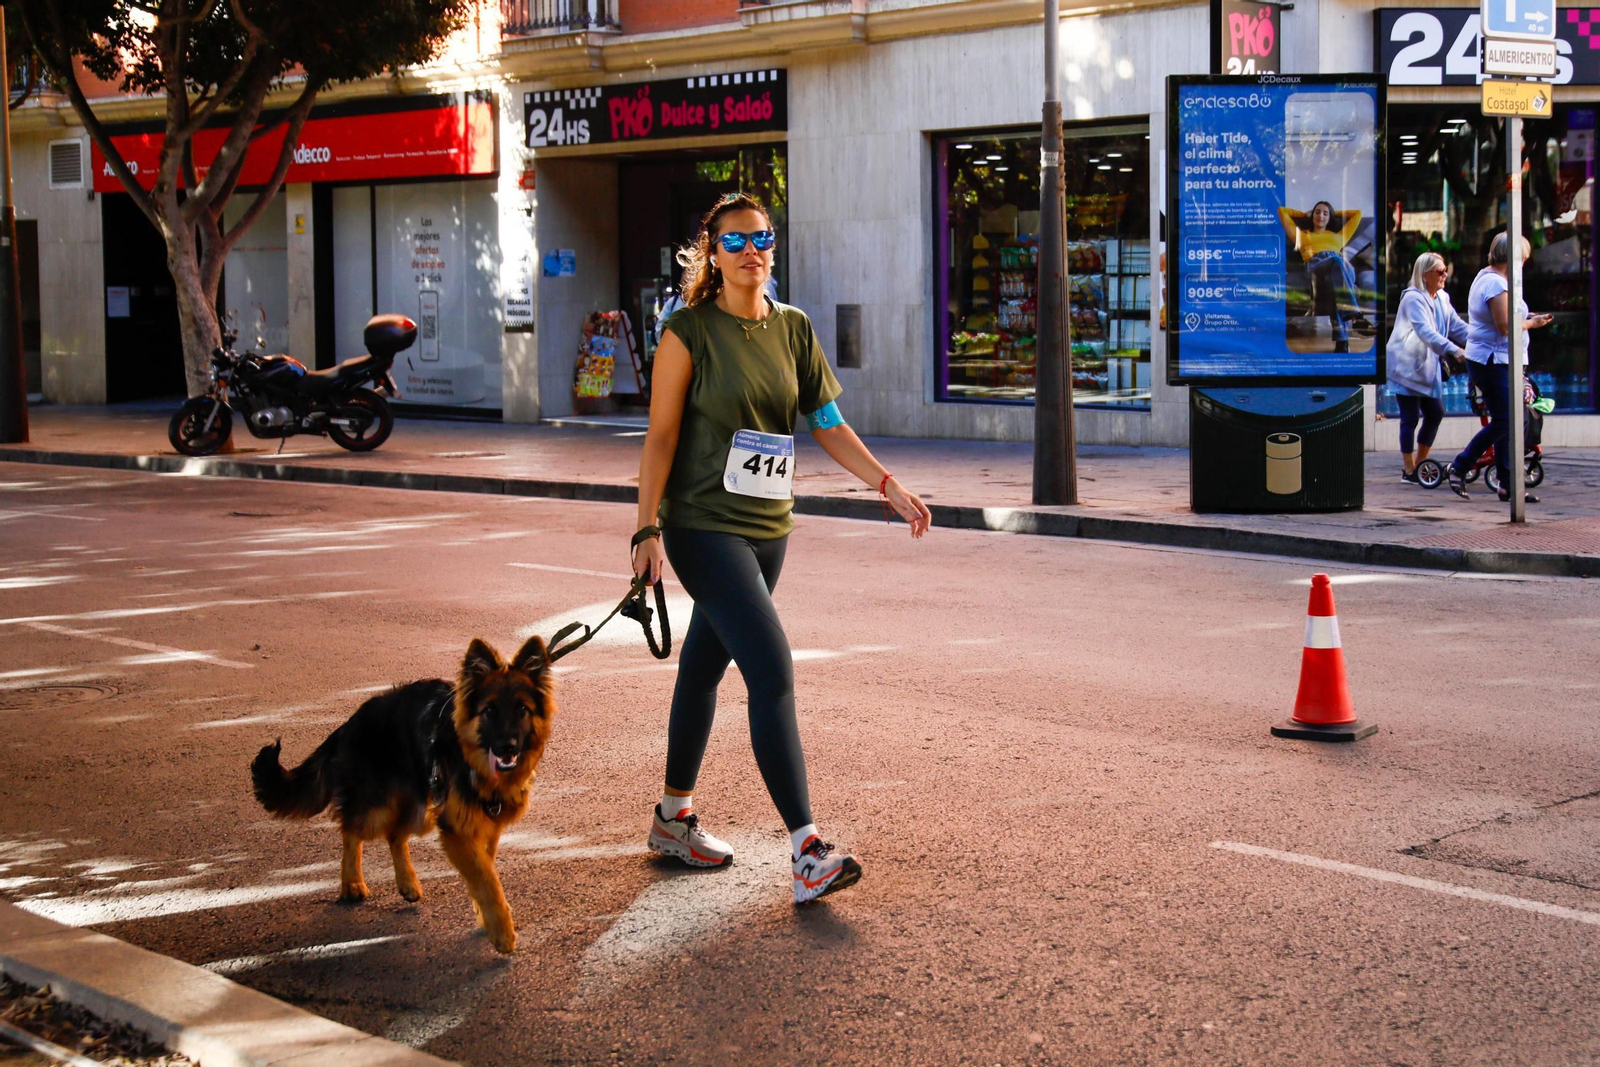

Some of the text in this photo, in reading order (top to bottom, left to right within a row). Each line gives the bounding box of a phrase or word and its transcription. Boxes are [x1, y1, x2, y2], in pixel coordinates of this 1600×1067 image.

[1528, 23, 1545, 33] 40 m
[1388, 12, 1574, 85] 24S
[1488, 49, 1553, 66] ALMERICENTRO
[1258, 75, 1301, 83] JCDecaux
[1499, 86, 1517, 96] Hotel
[1487, 96, 1529, 112] Costasol
[661, 100, 704, 127] Dulce
[709, 101, 720, 129] y
[1185, 132, 1251, 145] Haier Tide,
[1185, 148, 1233, 159] el clima
[1185, 163, 1240, 177] perfecto
[1185, 178, 1276, 192] para tu ahorro.
[414, 231, 440, 242] mejores
[412, 259, 420, 269] de
[736, 438, 755, 446] contra
[743, 453, 787, 478] 414
